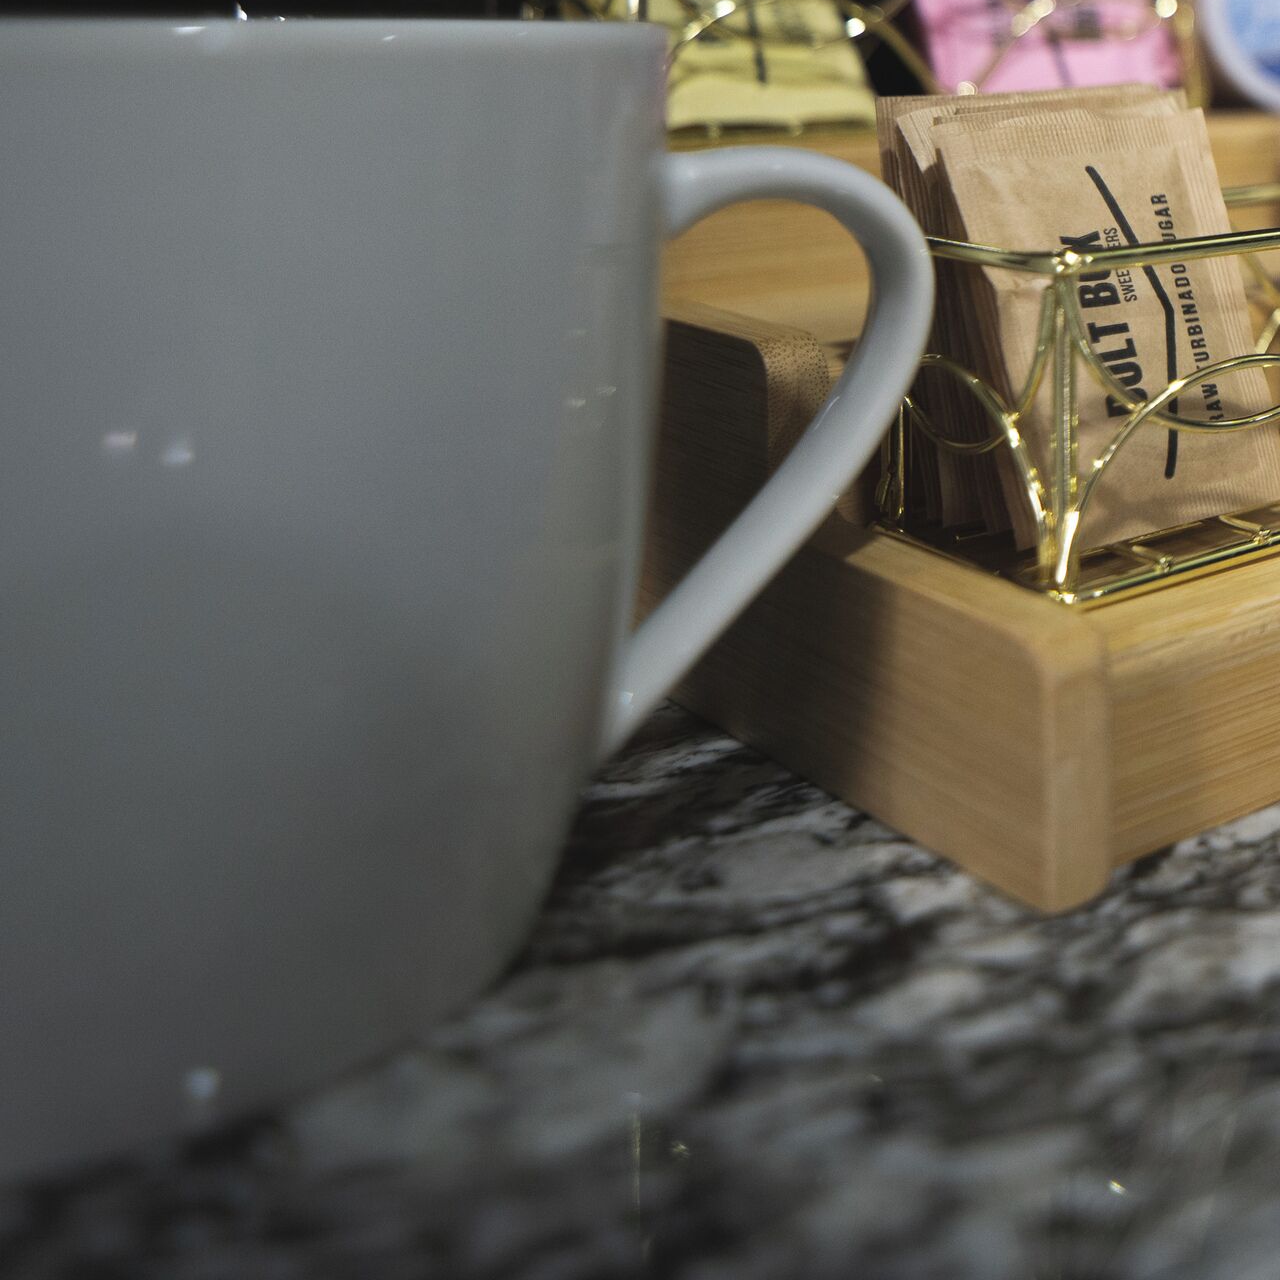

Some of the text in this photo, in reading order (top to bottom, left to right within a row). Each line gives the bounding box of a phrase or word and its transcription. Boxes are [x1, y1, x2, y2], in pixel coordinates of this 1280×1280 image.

[1151, 193, 1177, 243] UGAR
[1103, 227, 1138, 303] SWEEERS
[1170, 263, 1210, 369] URBINADO
